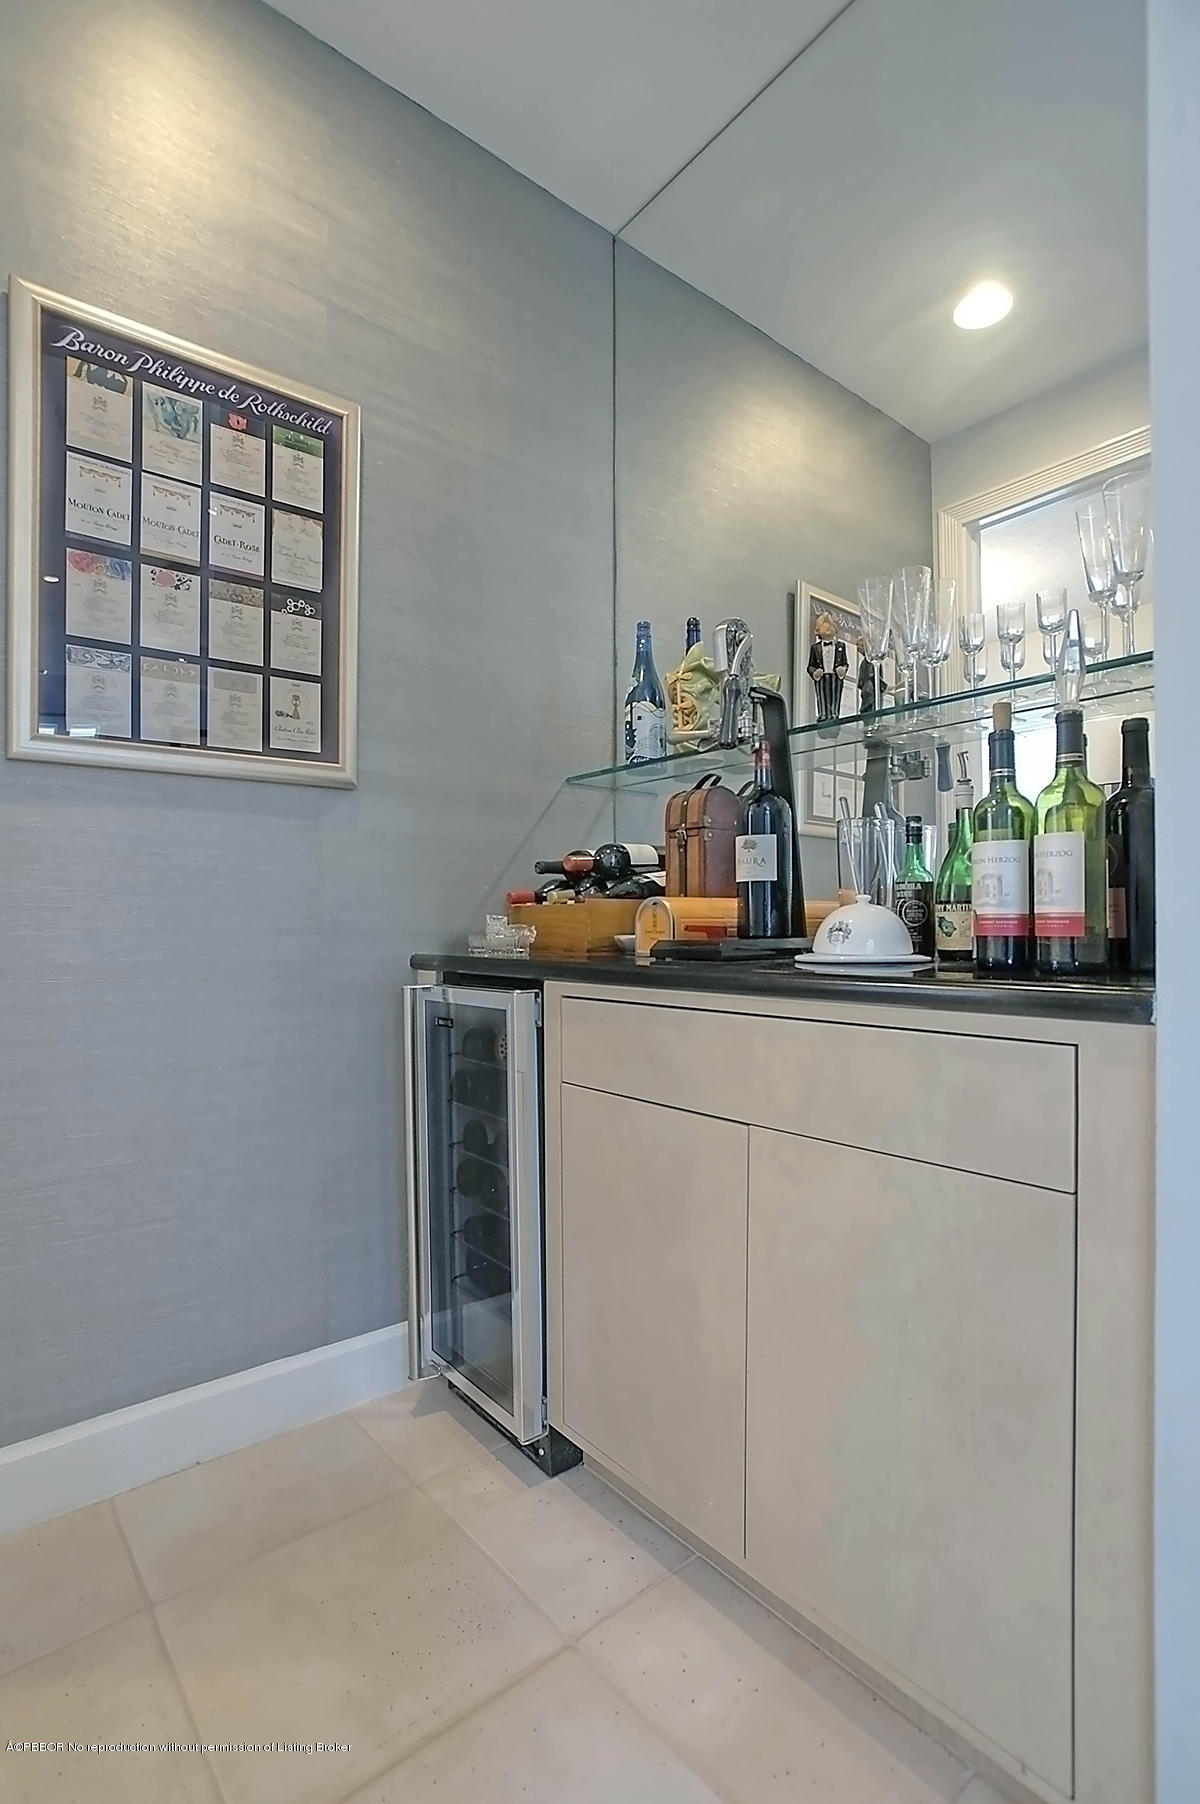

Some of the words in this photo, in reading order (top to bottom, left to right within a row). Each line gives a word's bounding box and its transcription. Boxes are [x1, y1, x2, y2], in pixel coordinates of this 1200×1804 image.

[49, 325, 129, 366] Baron
[126, 350, 215, 394] Philippe
[217, 385, 240, 403] de
[236, 392, 330, 435] Rothschild
